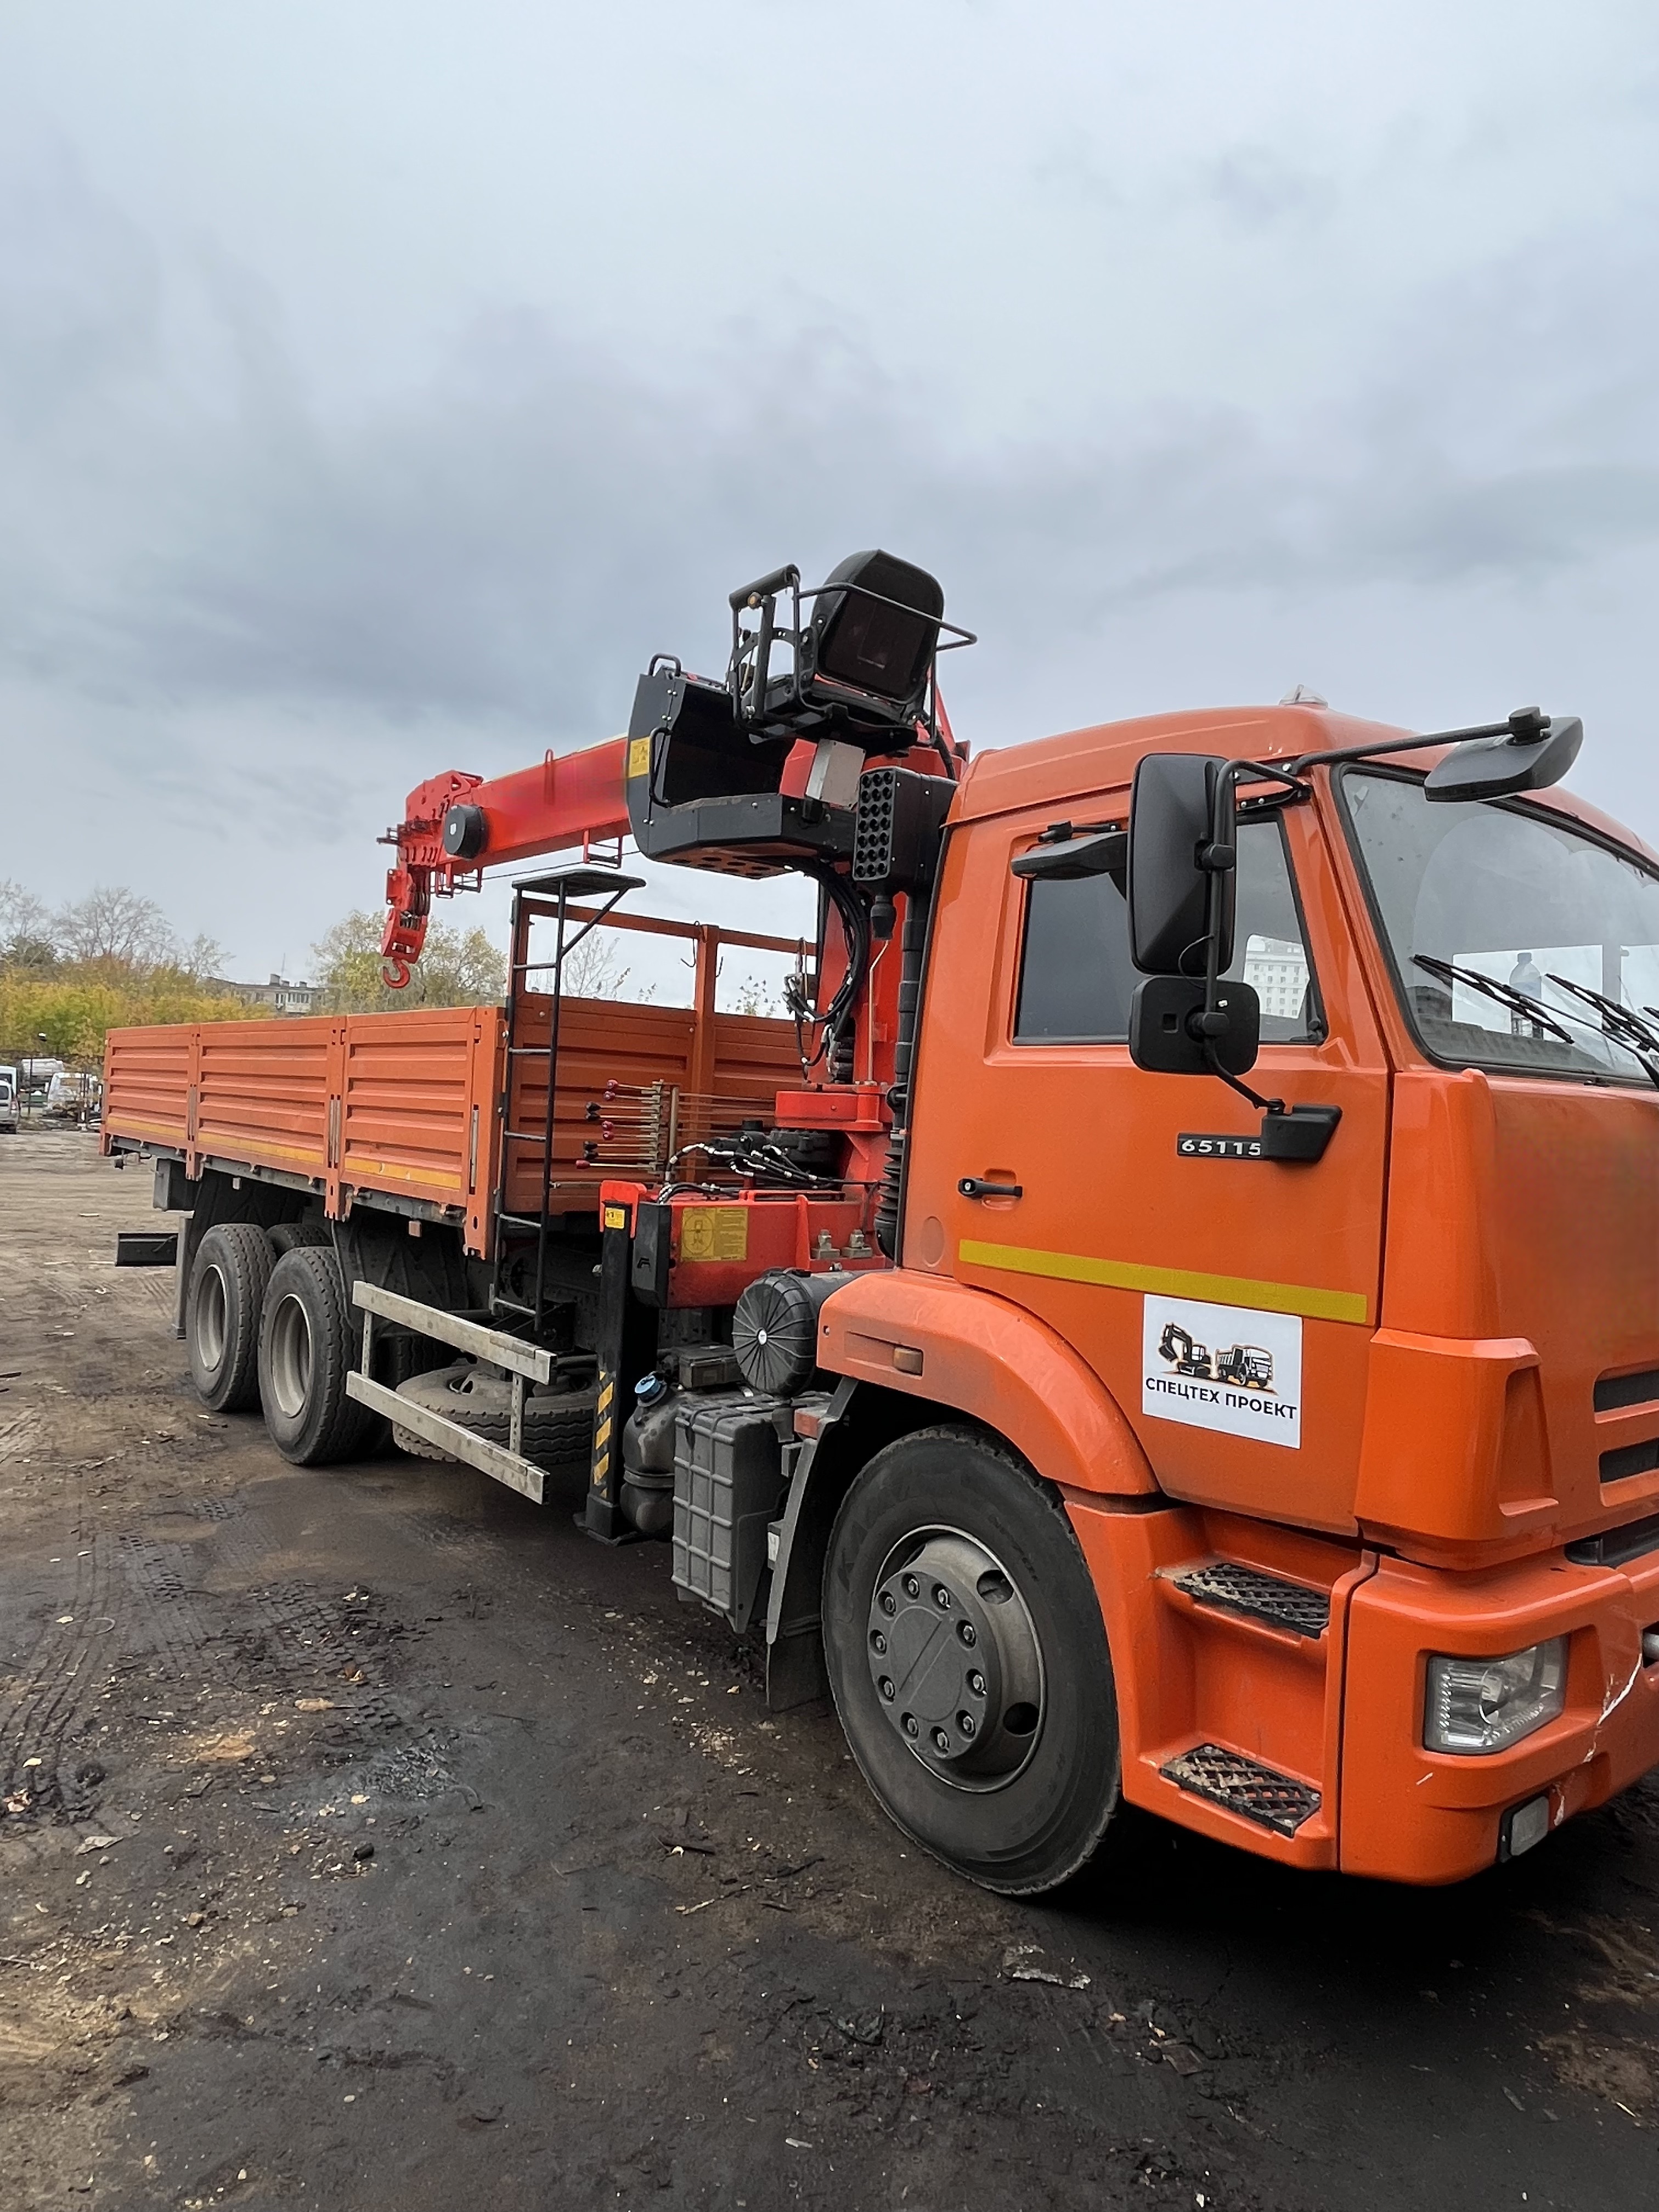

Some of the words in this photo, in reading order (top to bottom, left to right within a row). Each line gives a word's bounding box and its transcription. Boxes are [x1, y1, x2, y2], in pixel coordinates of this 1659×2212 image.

[1181, 1139, 1261, 1155] 65115
[1146, 1377, 1220, 1404] СПЕЦТЕХ
[1226, 1392, 1297, 1419] ПРОЕКТ
